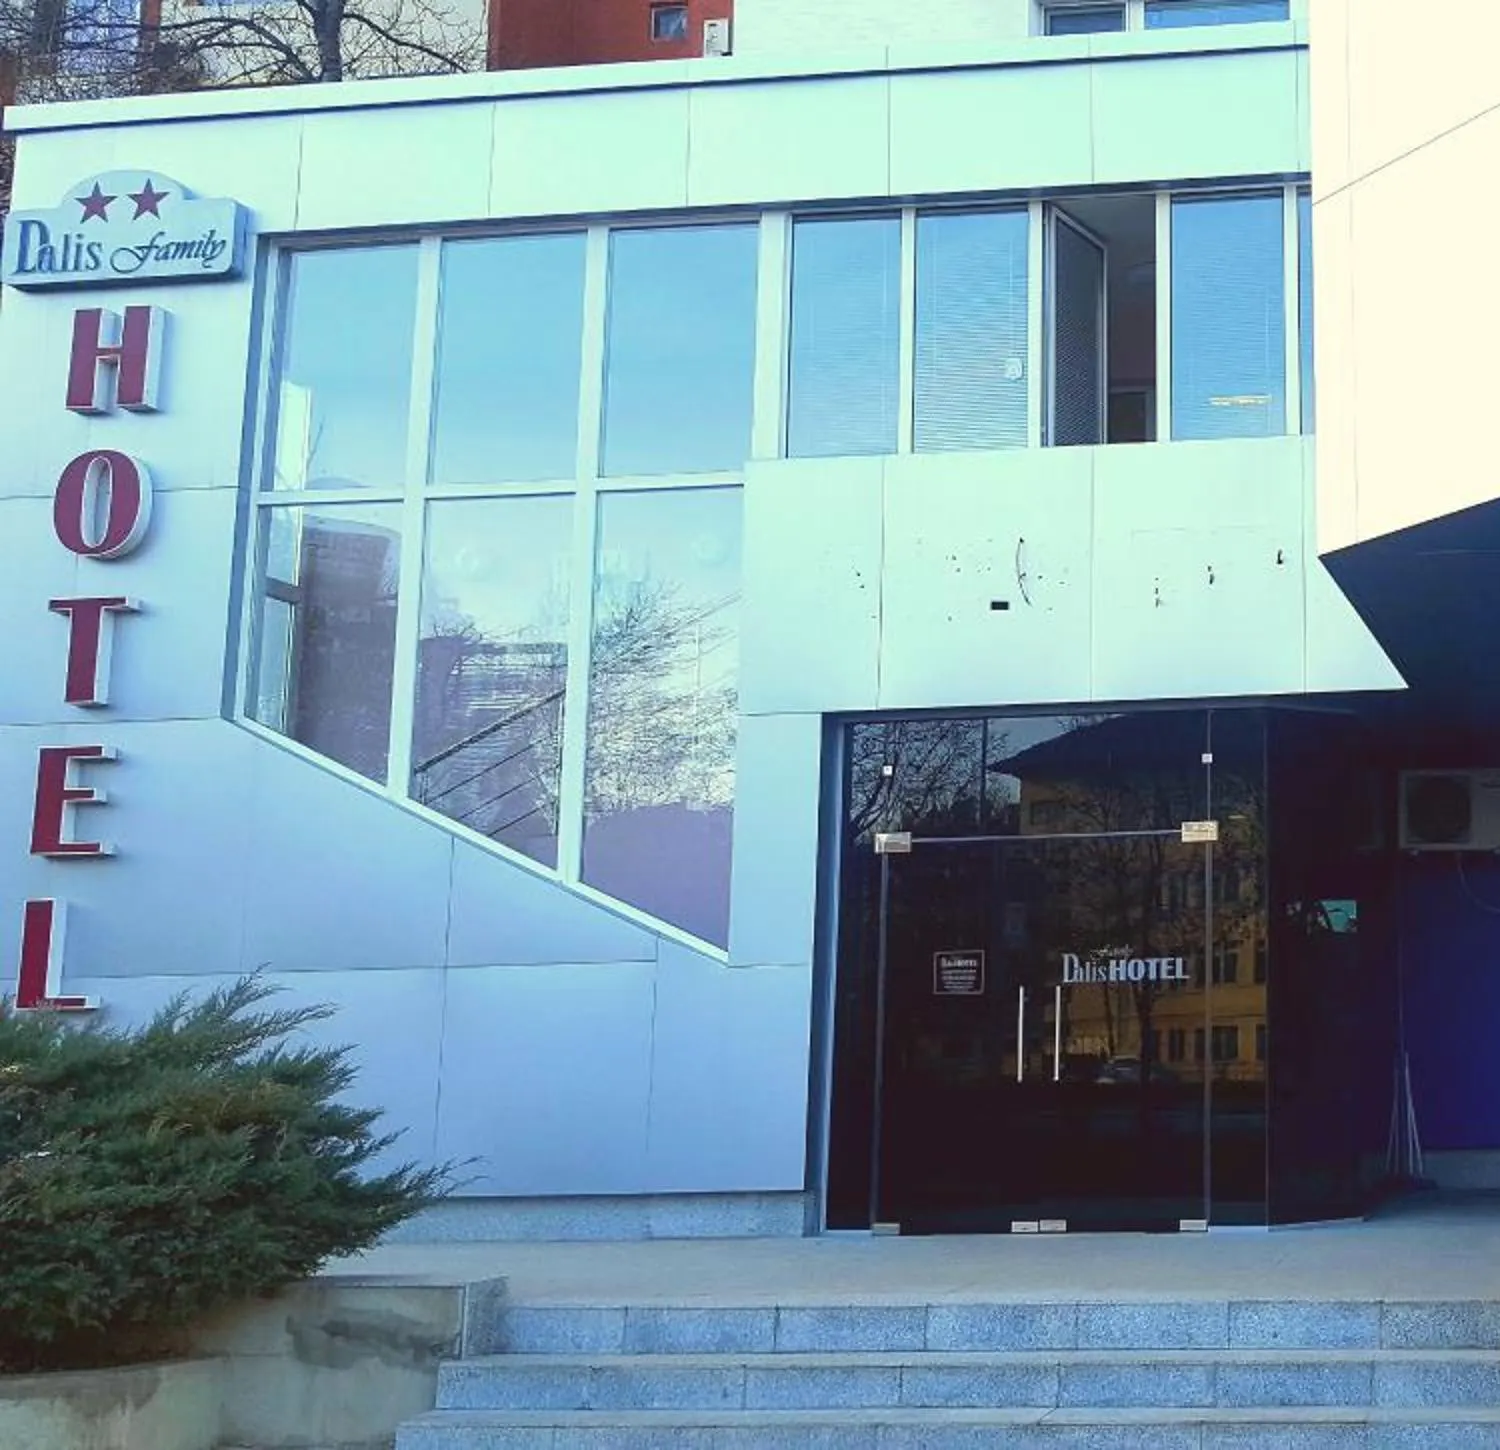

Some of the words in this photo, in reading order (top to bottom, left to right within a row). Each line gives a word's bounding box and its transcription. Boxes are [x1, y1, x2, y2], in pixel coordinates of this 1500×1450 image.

[13, 219, 103, 275] Dalis
[109, 229, 227, 273] Family
[15, 304, 172, 1011] HOTEL
